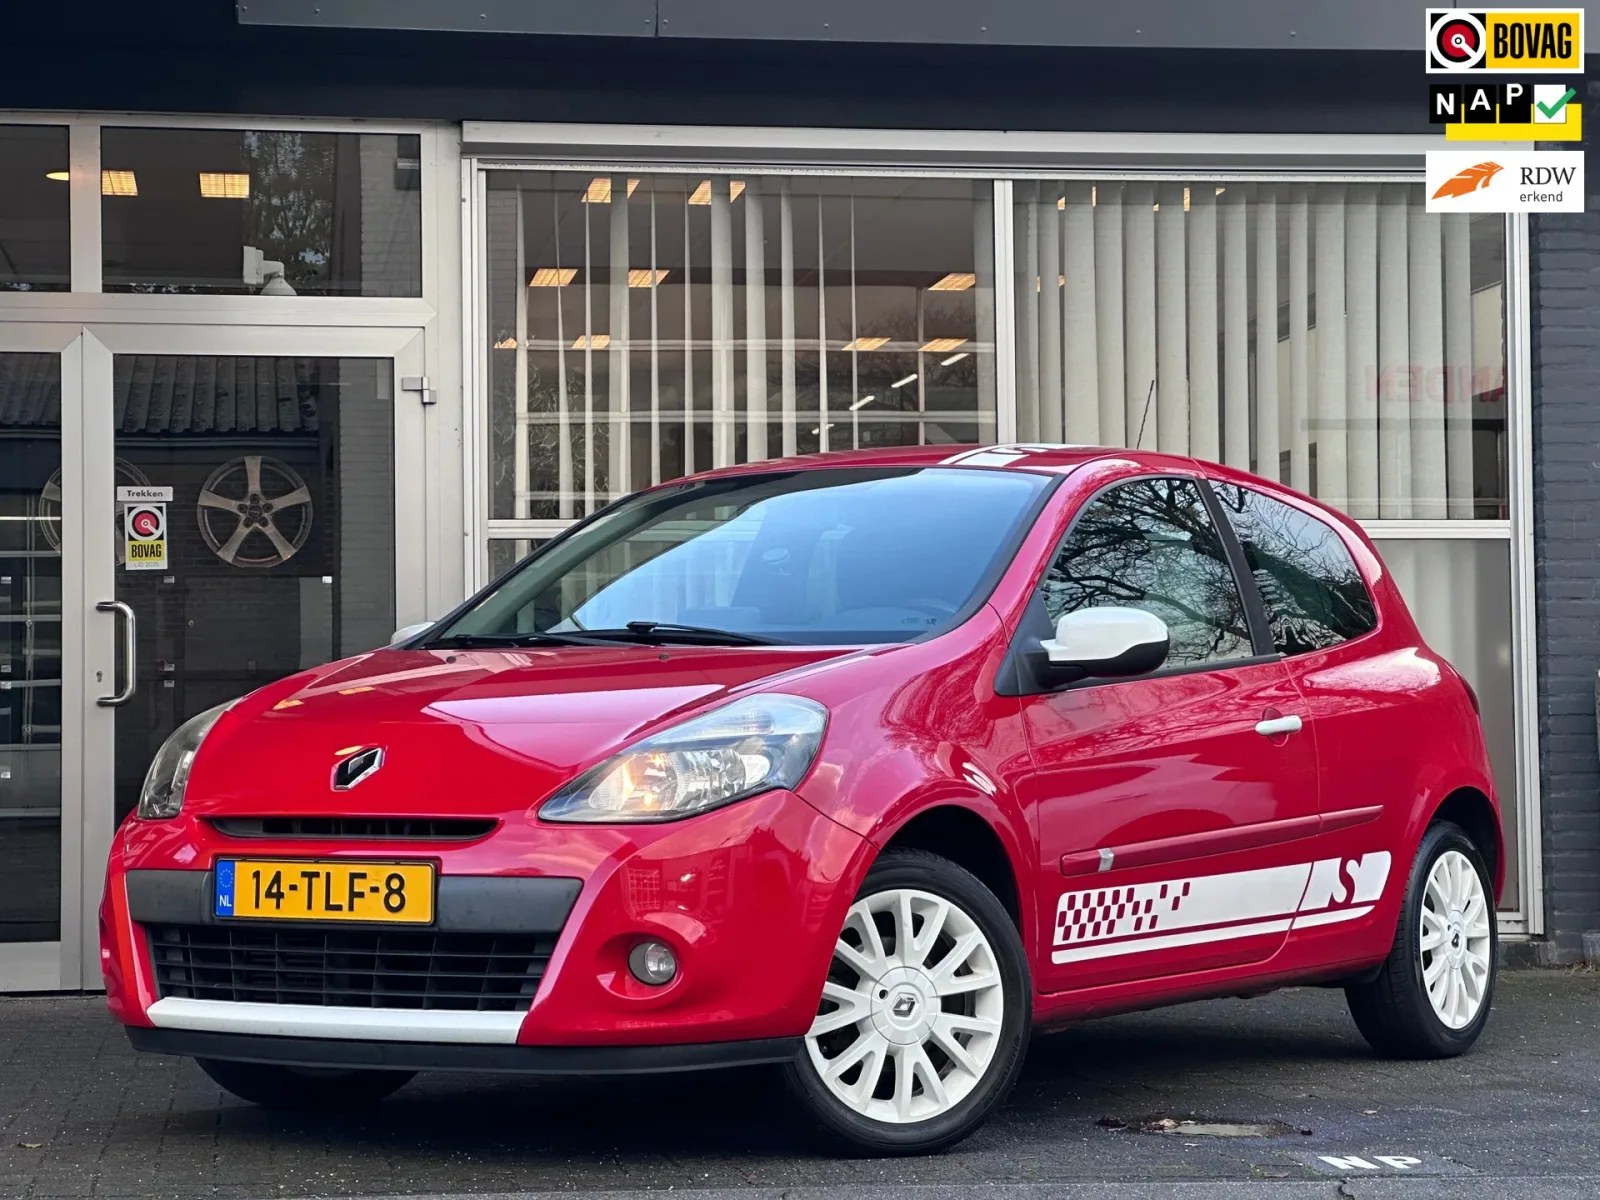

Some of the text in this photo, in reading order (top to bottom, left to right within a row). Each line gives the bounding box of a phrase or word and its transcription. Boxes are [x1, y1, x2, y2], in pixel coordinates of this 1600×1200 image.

[131, 544, 161, 558] BOVAG
[219, 870, 406, 913] NL 14-TLF-8
